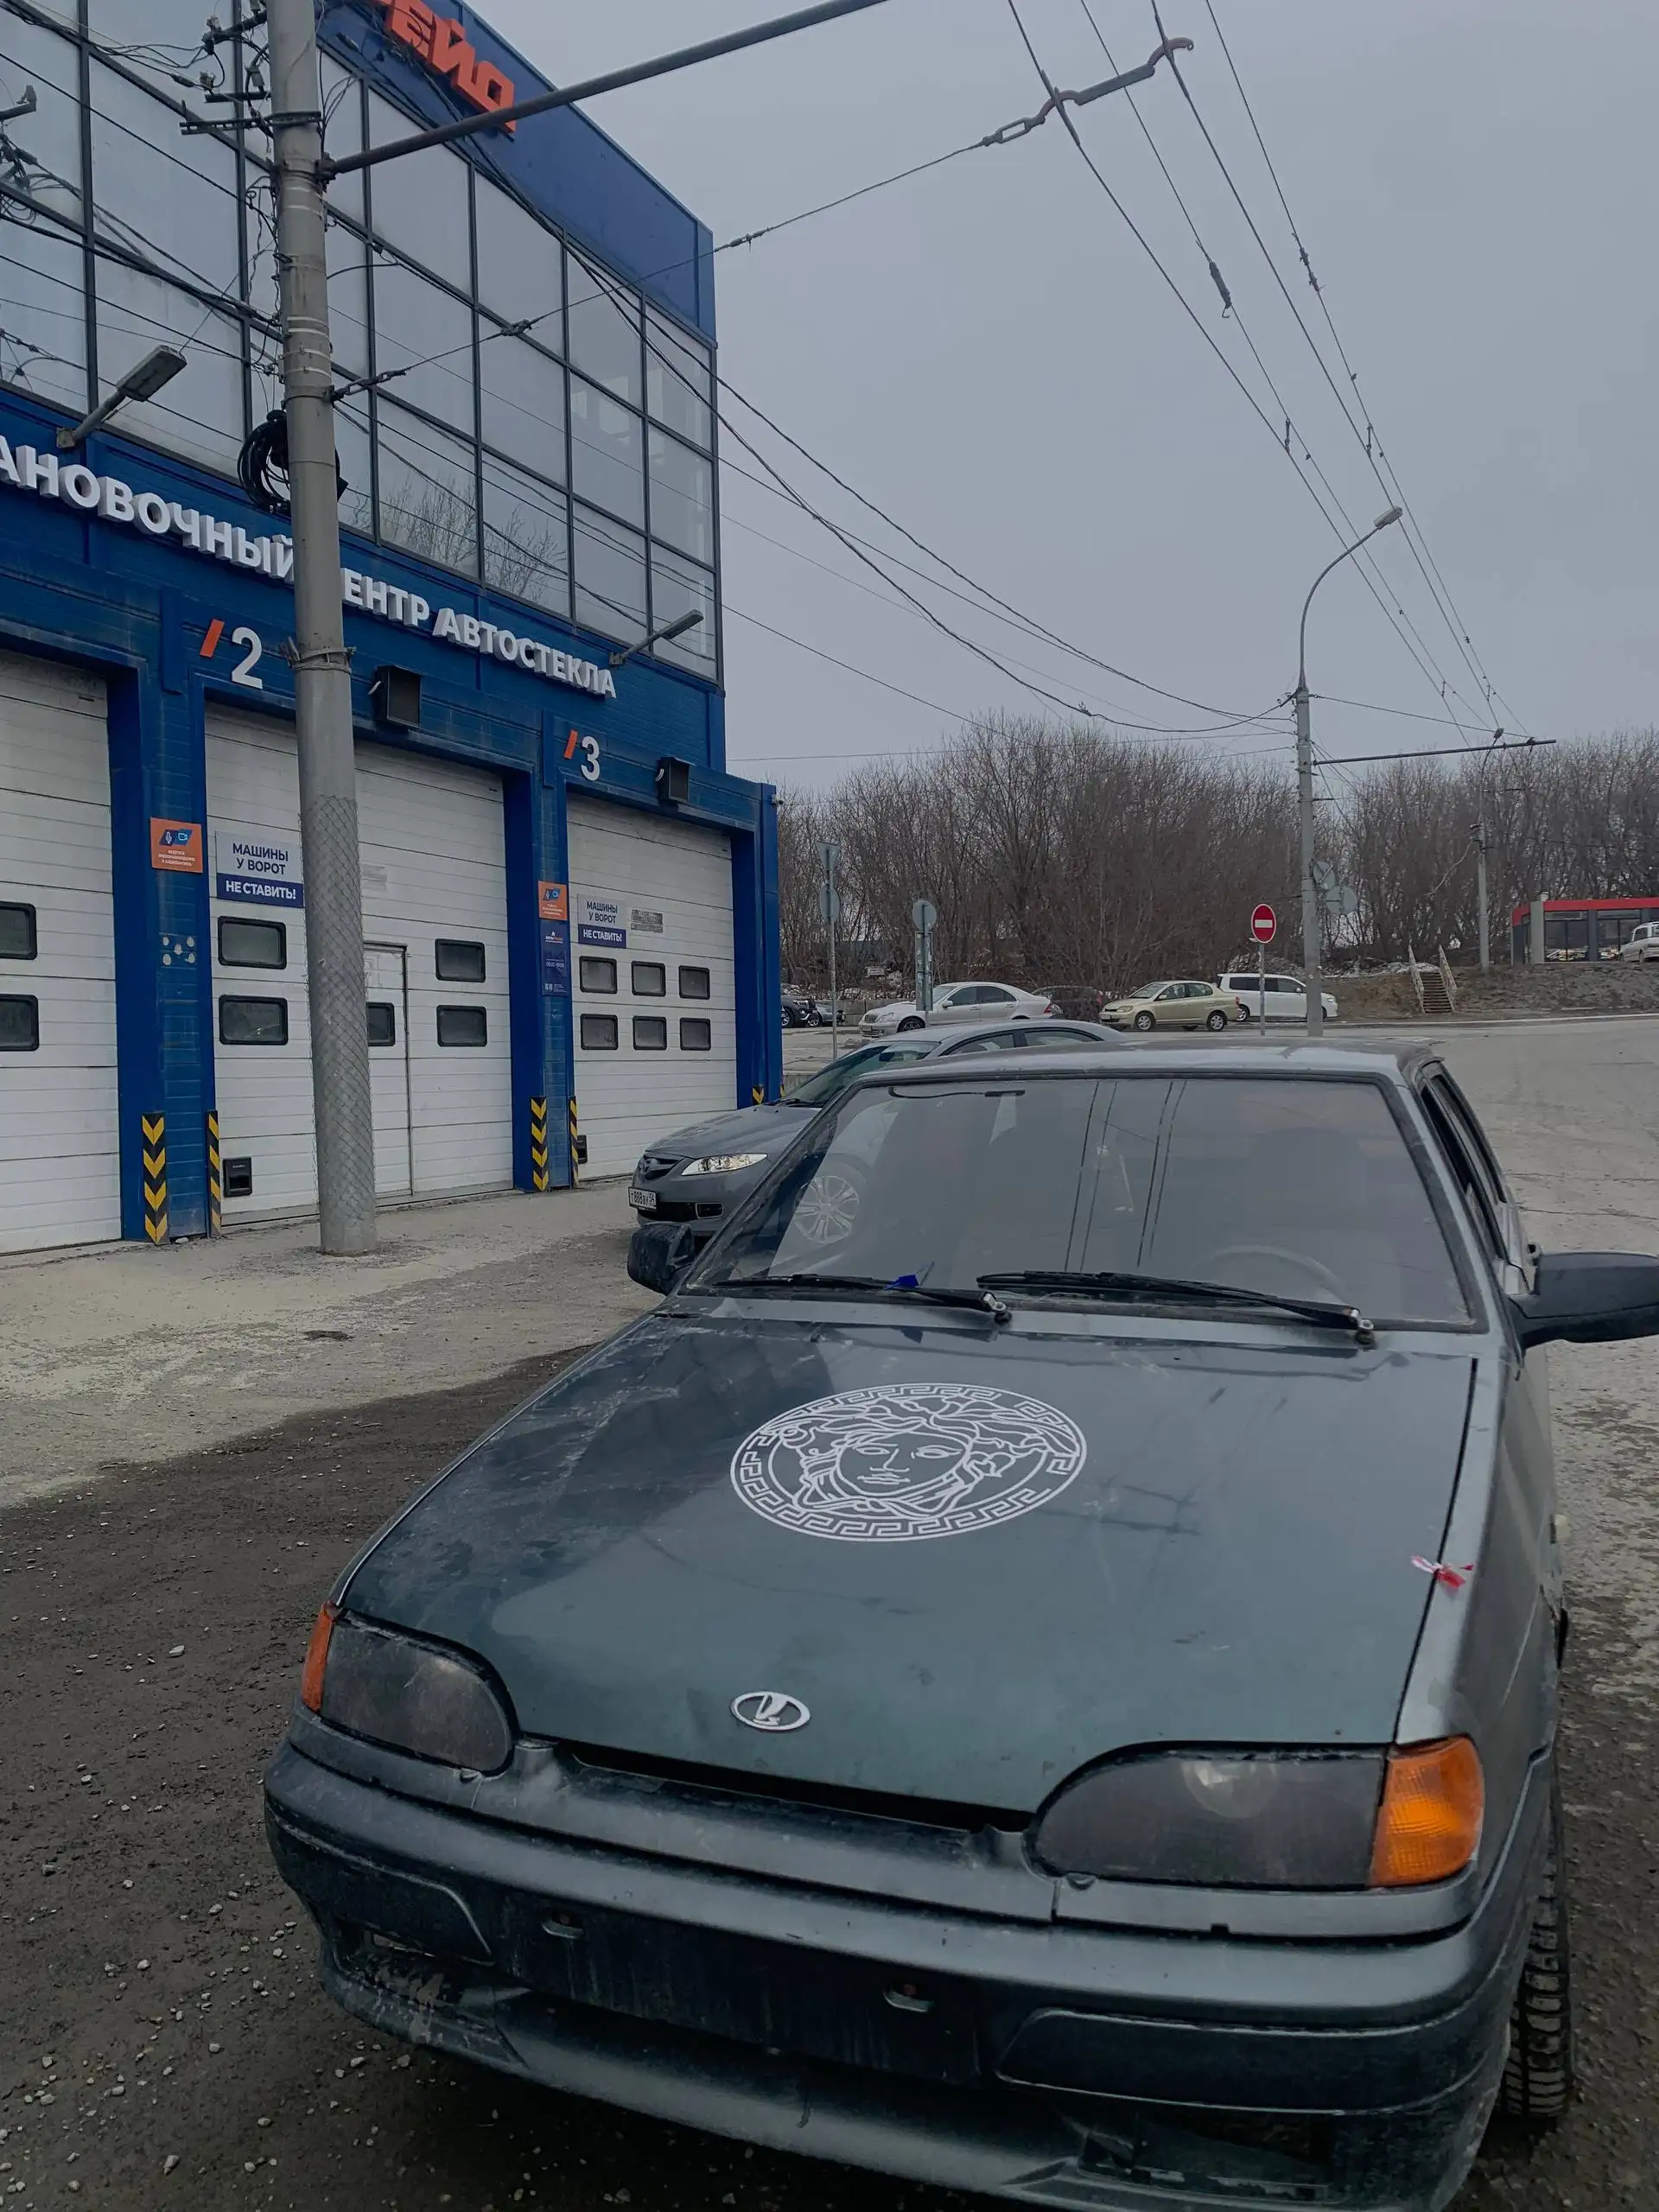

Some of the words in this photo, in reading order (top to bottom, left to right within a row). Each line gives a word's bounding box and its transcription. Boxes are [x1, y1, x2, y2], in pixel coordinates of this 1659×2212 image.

[340, 568, 430, 628] ЕНТР
[432, 607, 616, 698] АВТОСТЕКЛА
[232, 842, 289, 861] МАШИНЫ
[236, 857, 244, 869] У
[247, 859, 286, 875] ВОРОТ
[587, 901, 618, 913] МАШИНЫ
[588, 911, 594, 921] У
[594, 912, 617, 924] ВОРОТ
